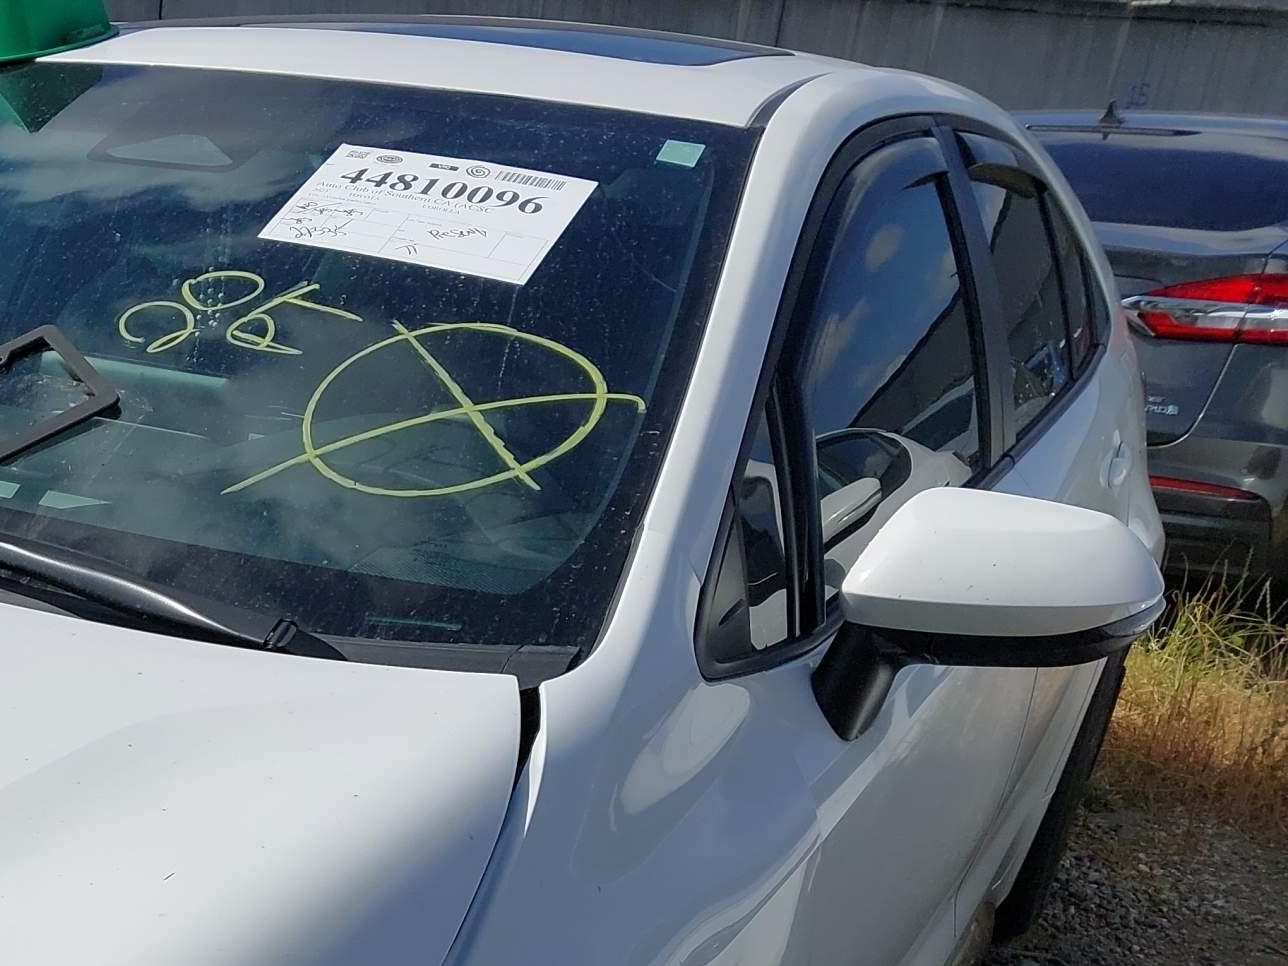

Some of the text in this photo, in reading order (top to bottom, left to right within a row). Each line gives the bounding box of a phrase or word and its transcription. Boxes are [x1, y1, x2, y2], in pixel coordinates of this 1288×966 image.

[316, 180, 342, 190] Auto
[344, 184, 369, 194] Club
[384, 190, 432, 203] Southern
[340, 167, 551, 215] 44810096
